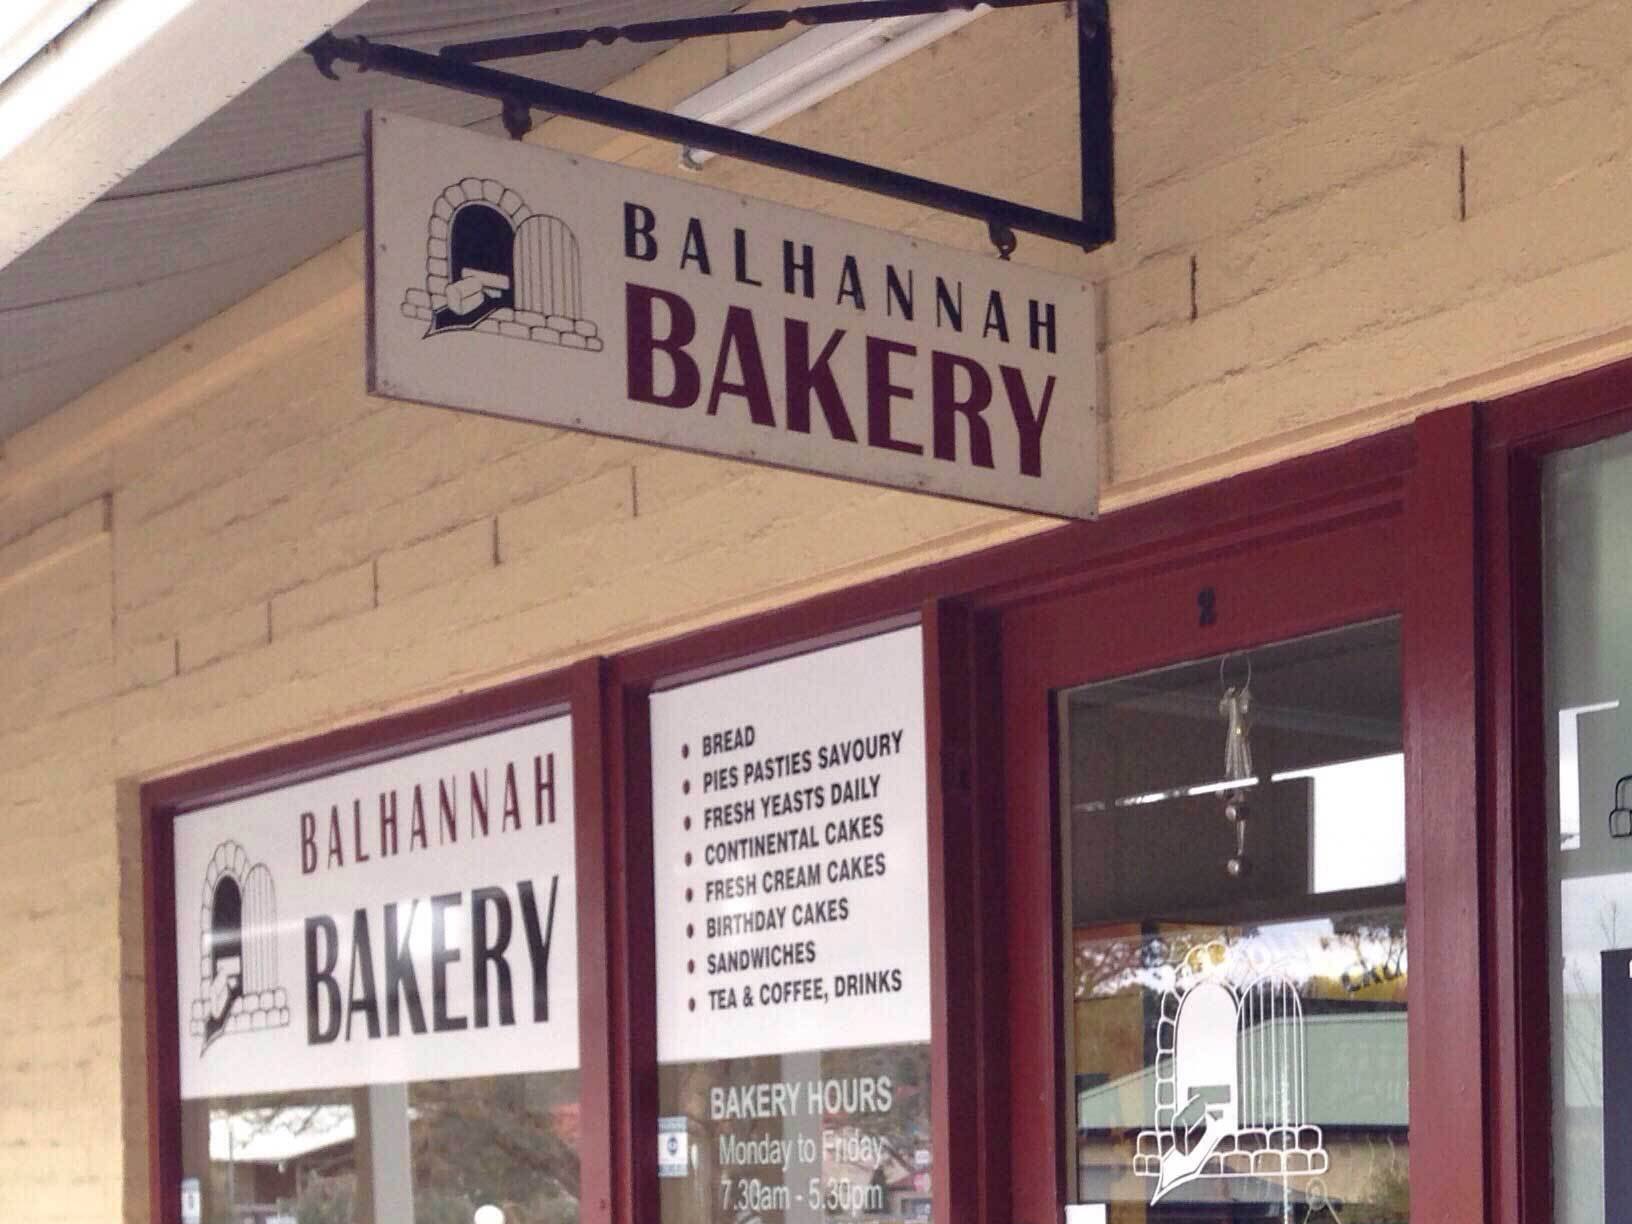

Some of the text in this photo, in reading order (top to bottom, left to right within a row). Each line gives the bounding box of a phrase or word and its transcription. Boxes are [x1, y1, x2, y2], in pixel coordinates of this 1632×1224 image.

[623, 202, 1057, 354] BALHANNAH
[625, 281, 1057, 479] BAKERY
[702, 725, 755, 757] BREAD
[703, 729, 903, 793] PIES PASTIES SAVOURY
[300, 752, 557, 875] BALHANNAH
[704, 774, 881, 830] FRESH YEASTS DAILY
[705, 814, 884, 866] CONTINENTAL CAKES
[706, 853, 886, 902] FRESH CREAM CAKES
[706, 898, 849, 938] BIRTHDAY CAKES
[304, 874, 560, 1047] BAKERY
[707, 941, 816, 975] SANDWICHES
[708, 969, 902, 1011] TEA & COFFEE, DRINKS
[711, 1076, 892, 1120] BAKERY HOURS
[719, 1128, 884, 1173] Monday to Friday
[721, 1179, 789, 1211] 7.30am
[808, 1178, 883, 1218] 5.30pm
